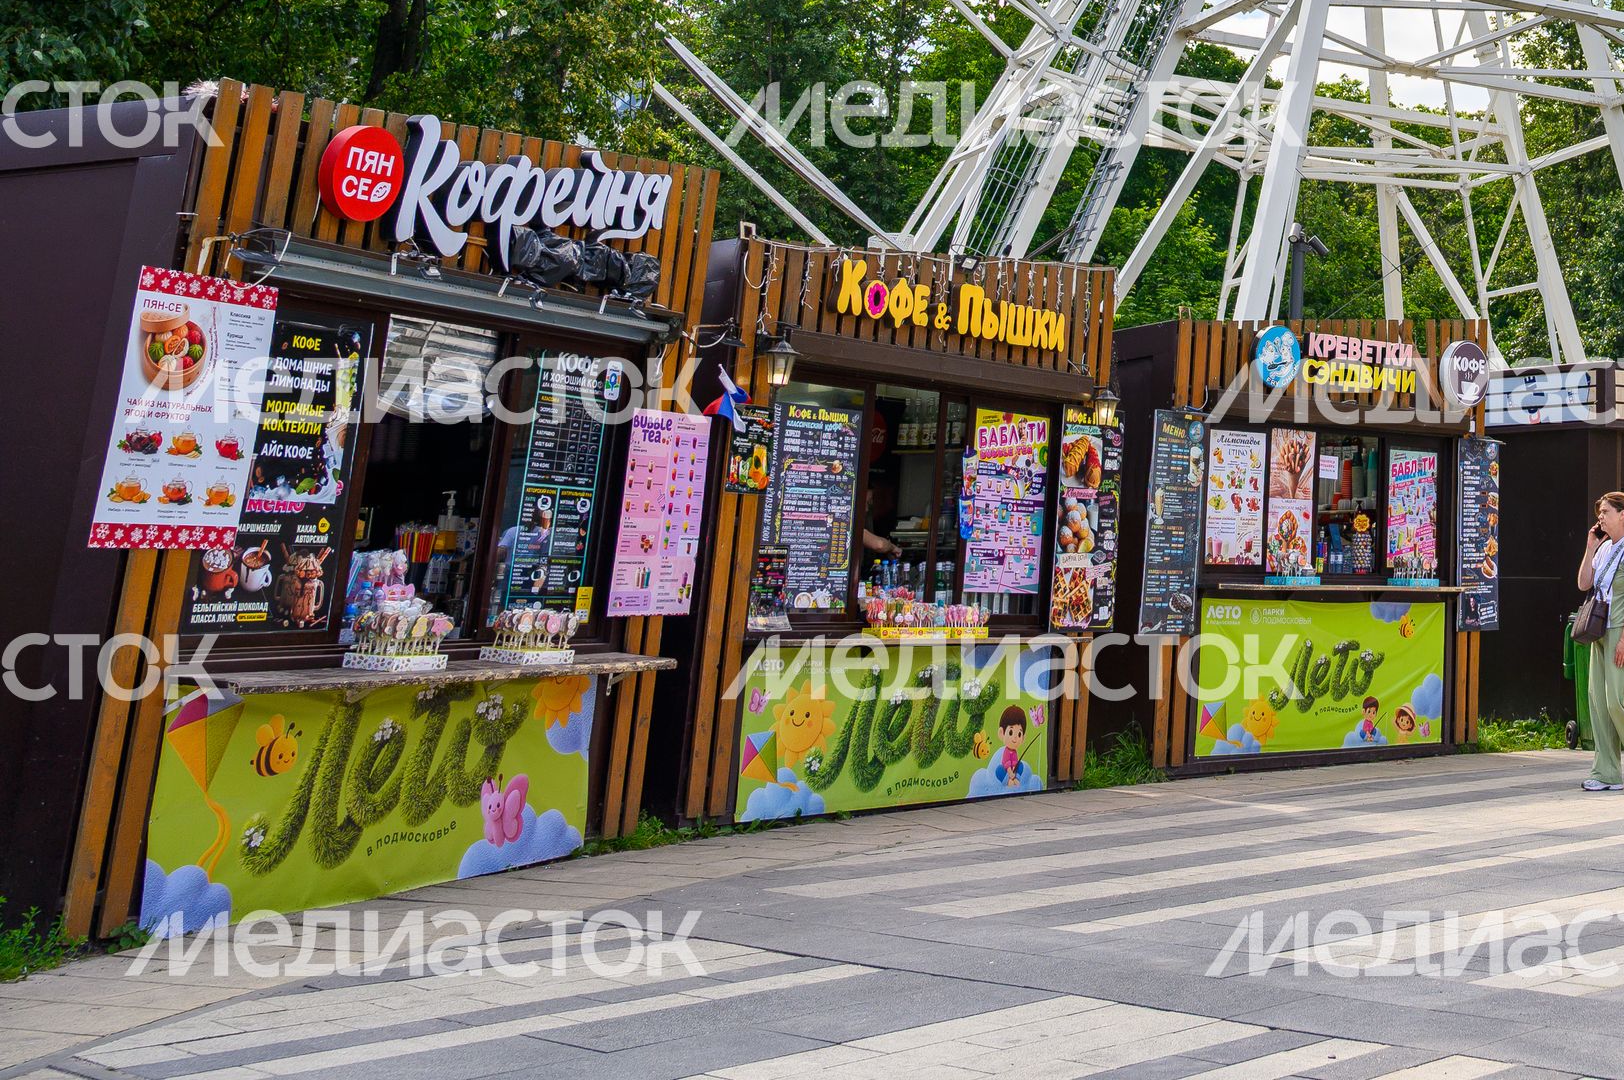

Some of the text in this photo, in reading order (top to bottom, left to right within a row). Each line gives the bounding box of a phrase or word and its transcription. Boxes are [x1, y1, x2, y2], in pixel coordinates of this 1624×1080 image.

[346, 146, 395, 177] ПЯН
[342, 175, 372, 202] СЕ
[395, 114, 672, 271] Кофейня
[143, 298, 182, 313] ПЯН-СЕ
[934, 303, 952, 331] &
[292, 335, 321, 351] КОФЕ
[1308, 332, 1413, 368] КРЕВЕТКИ
[273, 357, 333, 376] ДОМАШНИЕ
[556, 351, 601, 377] КОФЕ
[1453, 355, 1486, 375] КОФЕ
[269, 374, 331, 393] ЛИМОНАДЫ
[1302, 359, 1416, 394] СЭНДВИЧИ
[156, 401, 213, 414] НАТУРАЛЬНЫХ
[266, 399, 326, 418] МОЛОЧНЫЕ
[262, 416, 322, 435] КОКТЕЙЛИ
[261, 440, 314, 459] АЙС КОФЕ
[294, 532, 329, 544] АВТОРСКИЙ
[296, 523, 317, 534] КАКАО
[192, 601, 269, 612] БЕЛЬГИЙСКИЙ ШОКОЛАД
[1263, 608, 1285, 617] ПАРКИ
[190, 613, 217, 623] КЛАССА
[217, 612, 236, 623] ЛЮКС
